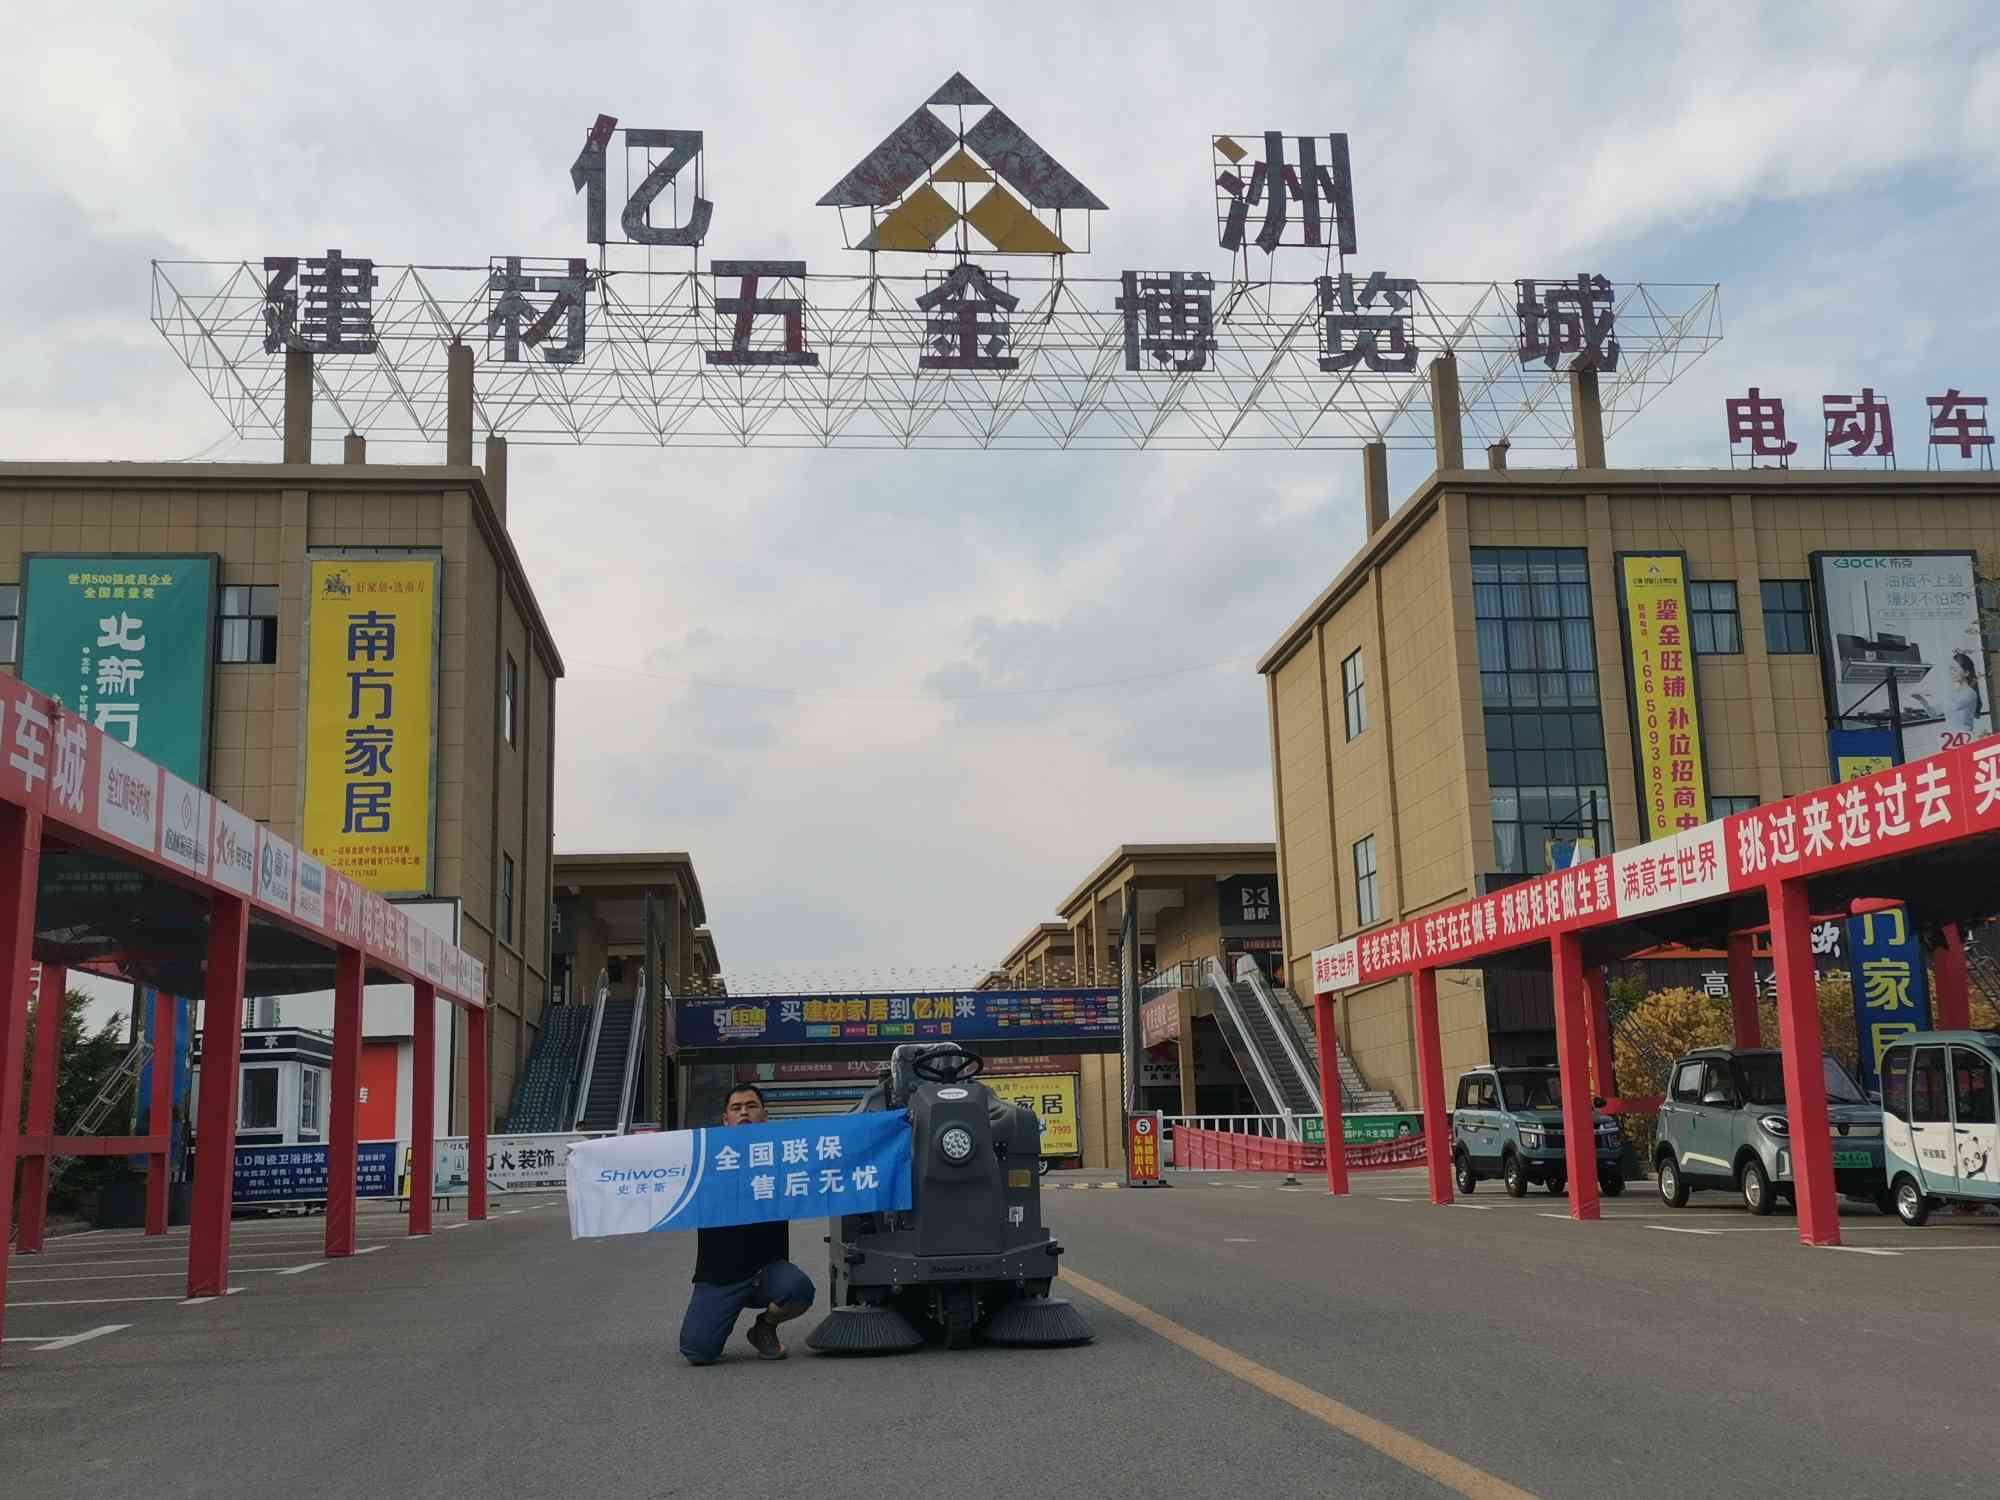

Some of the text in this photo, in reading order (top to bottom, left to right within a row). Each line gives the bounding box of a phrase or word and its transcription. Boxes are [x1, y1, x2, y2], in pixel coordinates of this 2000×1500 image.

[341, 610, 396, 834] 南方家居
[1738, 763, 1952, 876] 挑过来选过去
[1621, 840, 1718, 902] 满意车世界
[1361, 863, 1612, 974] 老老实实做人 实实在在做事 规规矩矩做生意
[1315, 951, 1355, 985] 满意车世界
[780, 996, 976, 1024] 买建材家居到亿洲来
[1140, 1120, 1148, 1132] 5
[714, 1135, 843, 1172] 全国联保
[598, 1164, 688, 1183] Shiwosi
[616, 1181, 667, 1196] 史沃斯
[751, 1165, 880, 1201] 售后无忧
